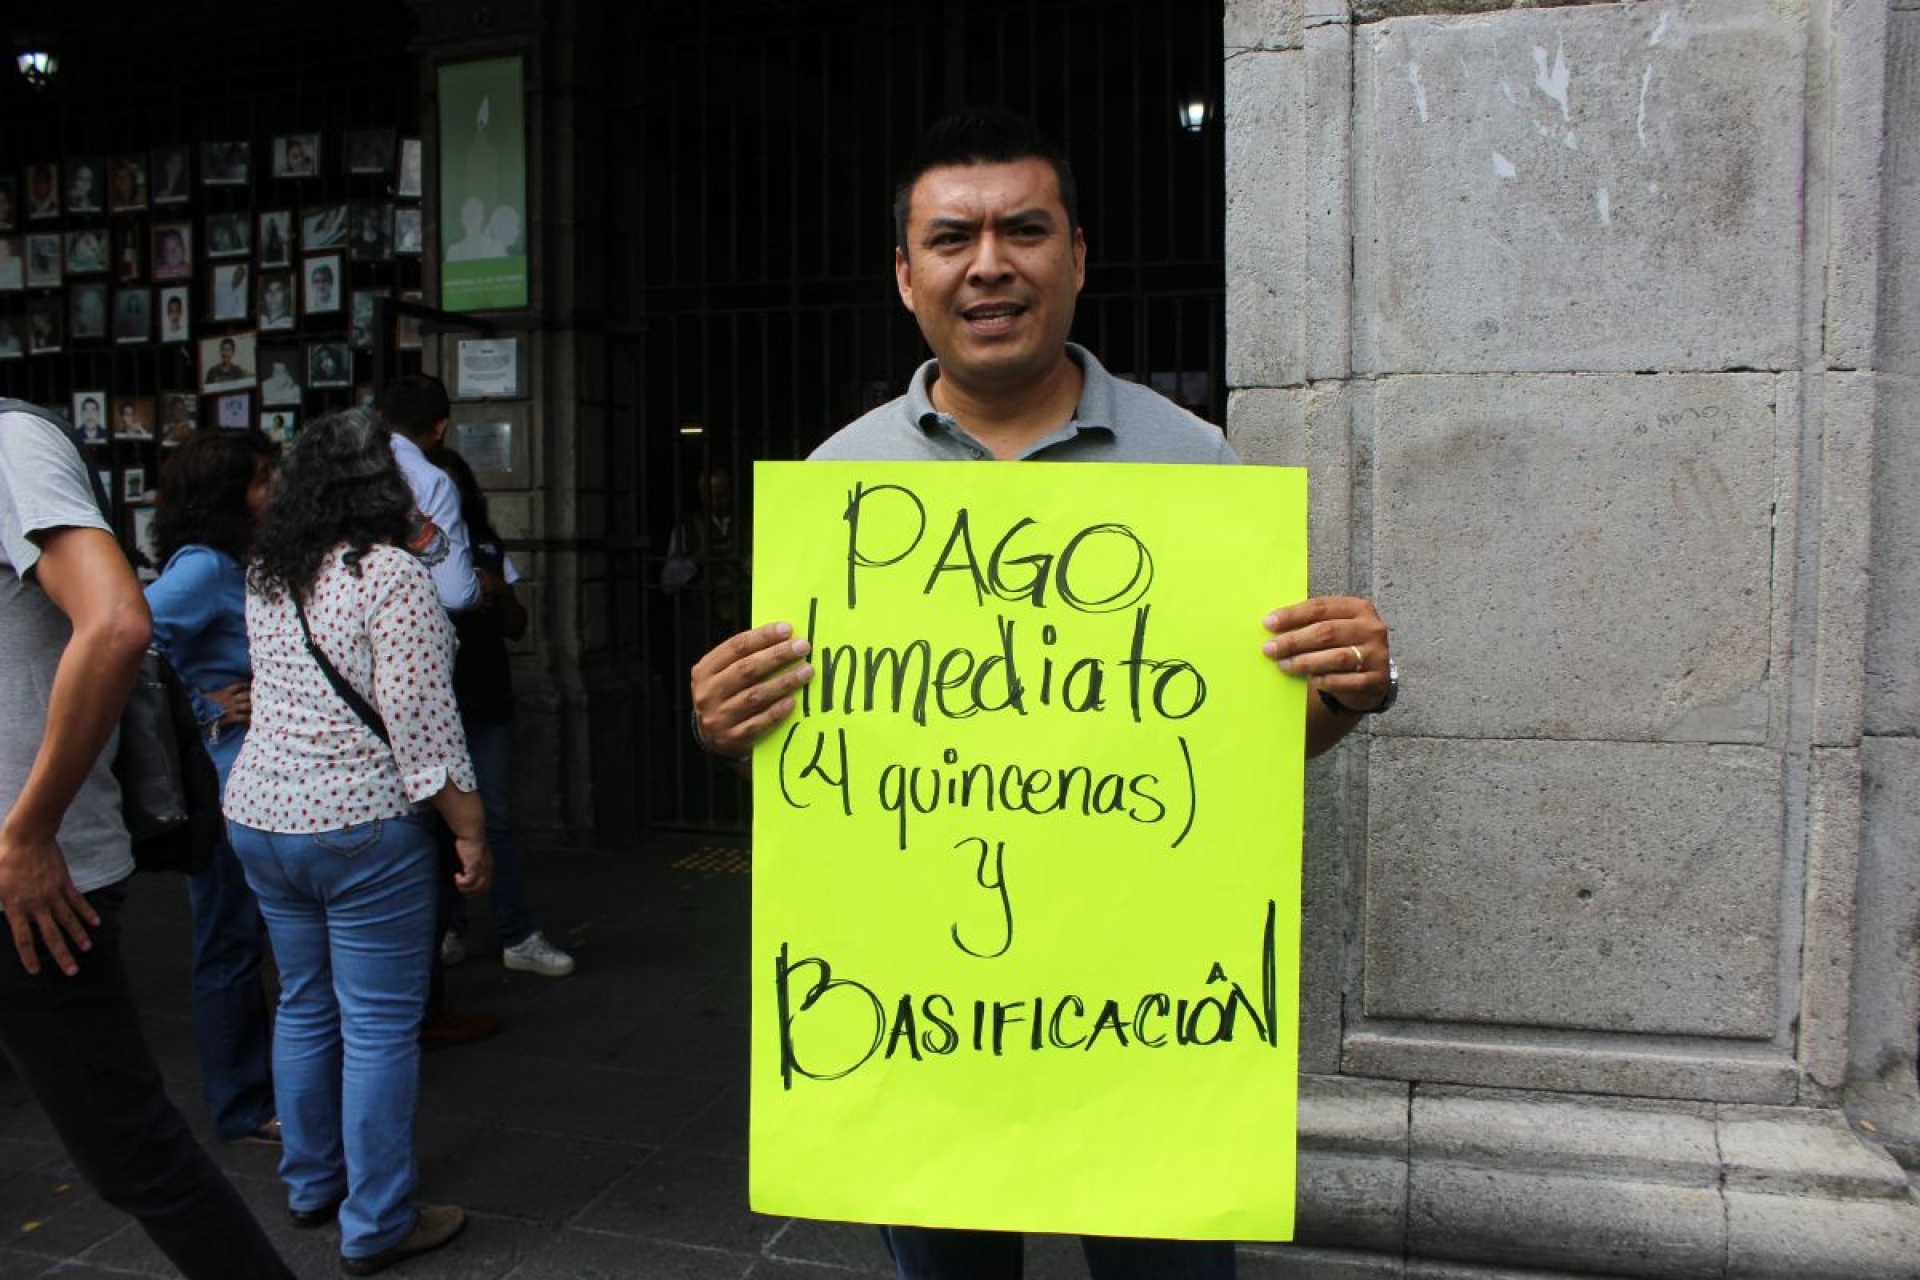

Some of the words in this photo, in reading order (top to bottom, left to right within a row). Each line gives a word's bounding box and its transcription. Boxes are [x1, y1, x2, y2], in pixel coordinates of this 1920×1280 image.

[843, 481, 1154, 613] PAGO
[801, 598, 1207, 726] Inmediato
[779, 721, 852, 816] (4
[879, 737, 1196, 850] quincenas)
